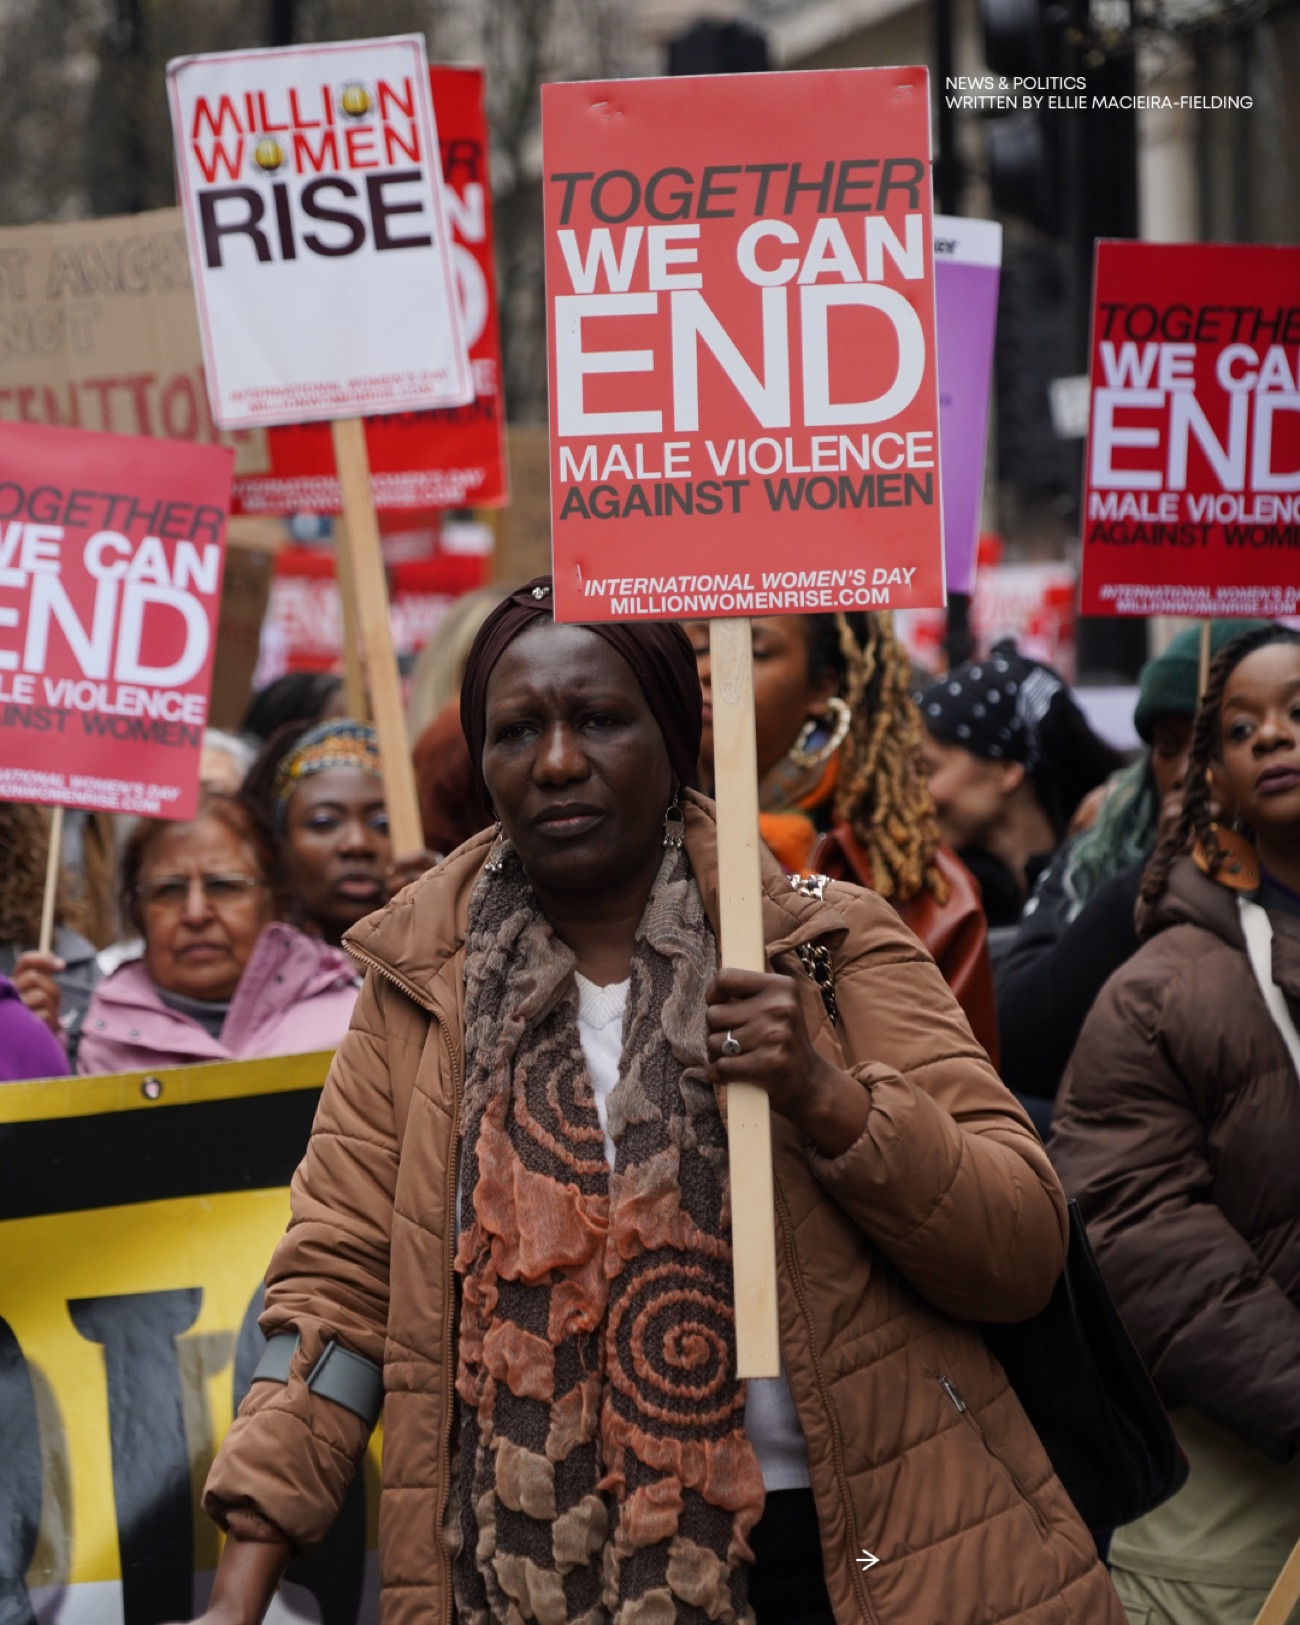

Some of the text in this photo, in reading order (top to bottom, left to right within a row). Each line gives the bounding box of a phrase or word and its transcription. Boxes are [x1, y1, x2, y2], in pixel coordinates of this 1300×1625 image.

[549, 157, 925, 226] TOGETHER
[197, 170, 432, 268] RISE
[557, 214, 924, 294] WE CAN
[555, 283, 926, 437] END
[1100, 340, 1300, 394] WE CA
[559, 432, 935, 482] MALE VIOLENCE
[559, 472, 934, 521] AGAINST WOMEN
[1089, 491, 1180, 523] MALE
[1089, 522, 1214, 547] AGAINST
[83, 530, 220, 595] CAN
[584, 566, 916, 597] INTERNATIONAL WOMEN'S DAY
[610, 587, 890, 615] MILLIONWOMENRISE.COM
[43, 677, 207, 725] VIOLENCE
[82, 711, 200, 748] WOMEN
